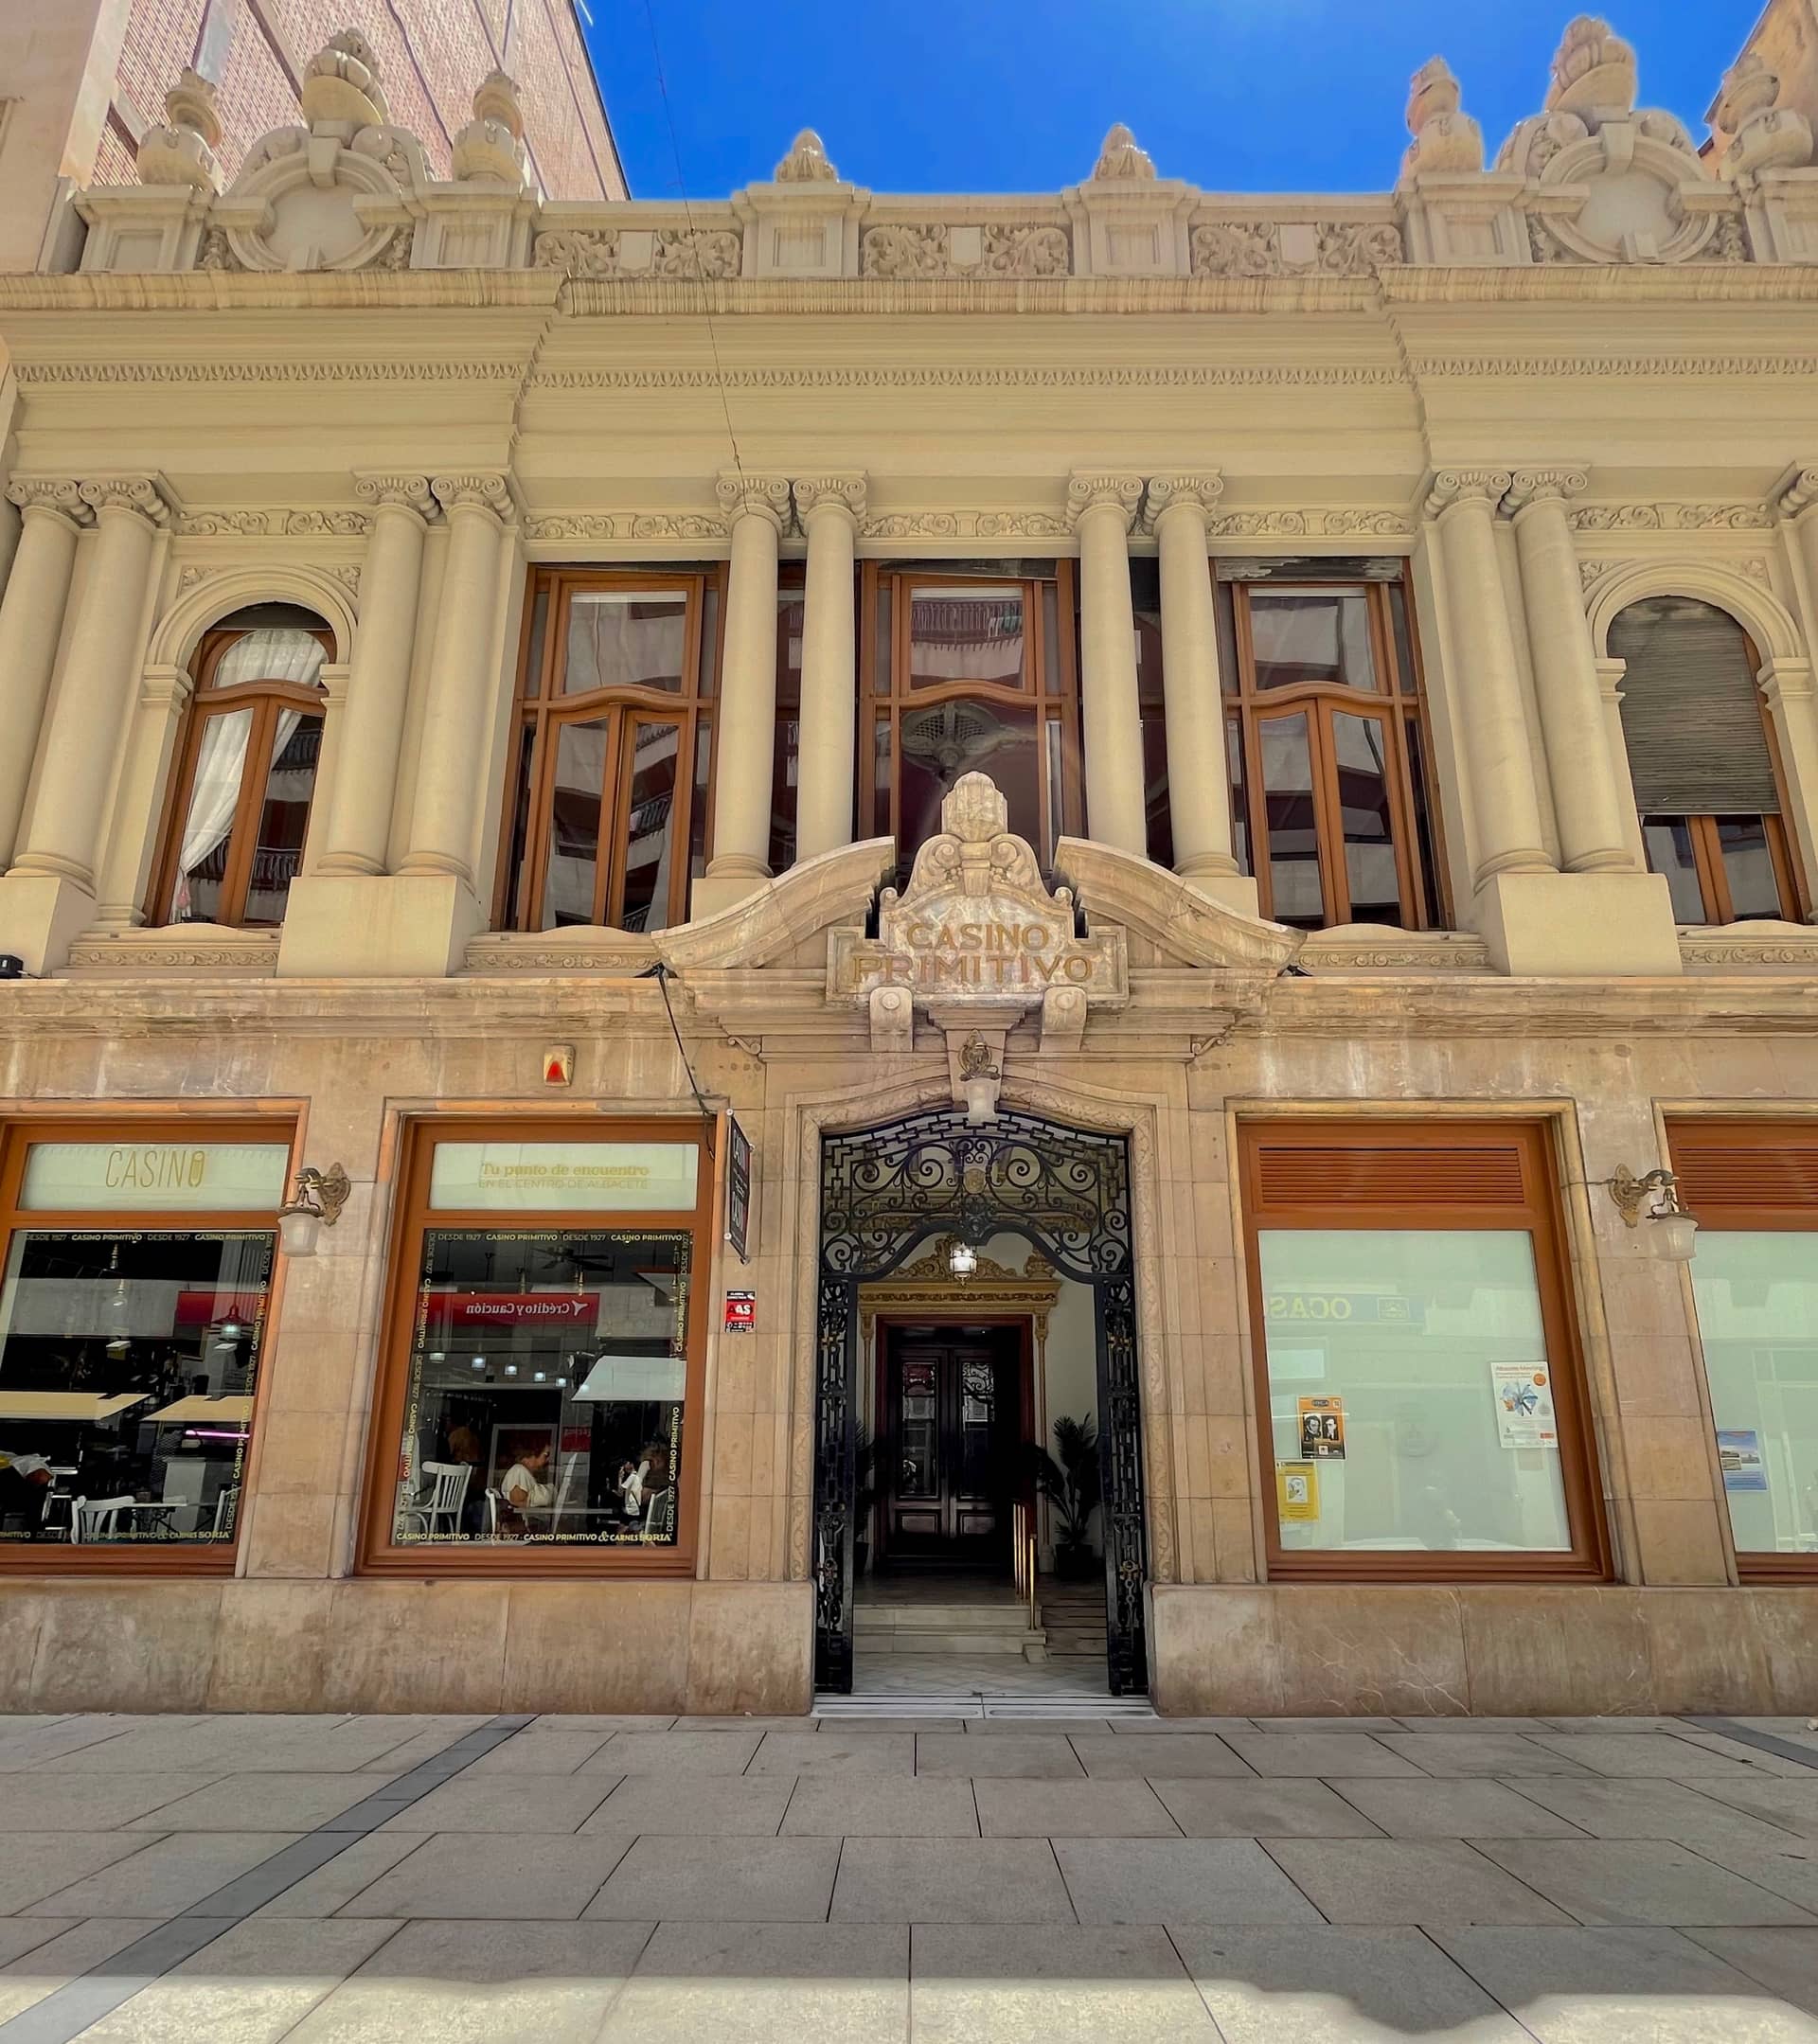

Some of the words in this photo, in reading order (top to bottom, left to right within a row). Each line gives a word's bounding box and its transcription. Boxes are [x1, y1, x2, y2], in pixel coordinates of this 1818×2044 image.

[906, 922, 1049, 951] CASINO
[852, 954, 1094, 983] PRIMITIVO
[105, 1149, 206, 1188] CASINO
[481, 1163, 500, 1176] Tu
[505, 1164, 547, 1178] punto
[551, 1164, 569, 1176] de
[573, 1164, 651, 1176] encuentro
[478, 1179, 494, 1189] EN
[499, 1179, 511, 1189] EL
[515, 1179, 566, 1189] CENTRO
[568, 1179, 583, 1189] DE
[587, 1179, 649, 1189] ALBACETE
[422, 1278, 432, 1307] CASINO
[677, 1281, 686, 1322] PRIMITIVO
[675, 1323, 685, 1352] CASINO
[408, 1403, 418, 1434] CASINO
[670, 1406, 680, 1449] PRIMITIVO
[233, 1448, 243, 1479] CASINO
[668, 1449, 678, 1482] CASINO
[666, 1502, 675, 1532] DESDE
[396, 1533, 427, 1541] CASINO
[428, 1533, 470, 1541] PRIMITIVO
[524, 1533, 554, 1541] CASINO
[556, 1533, 597, 1541] PRIMITIVO
[597, 1531, 609, 1542] &
